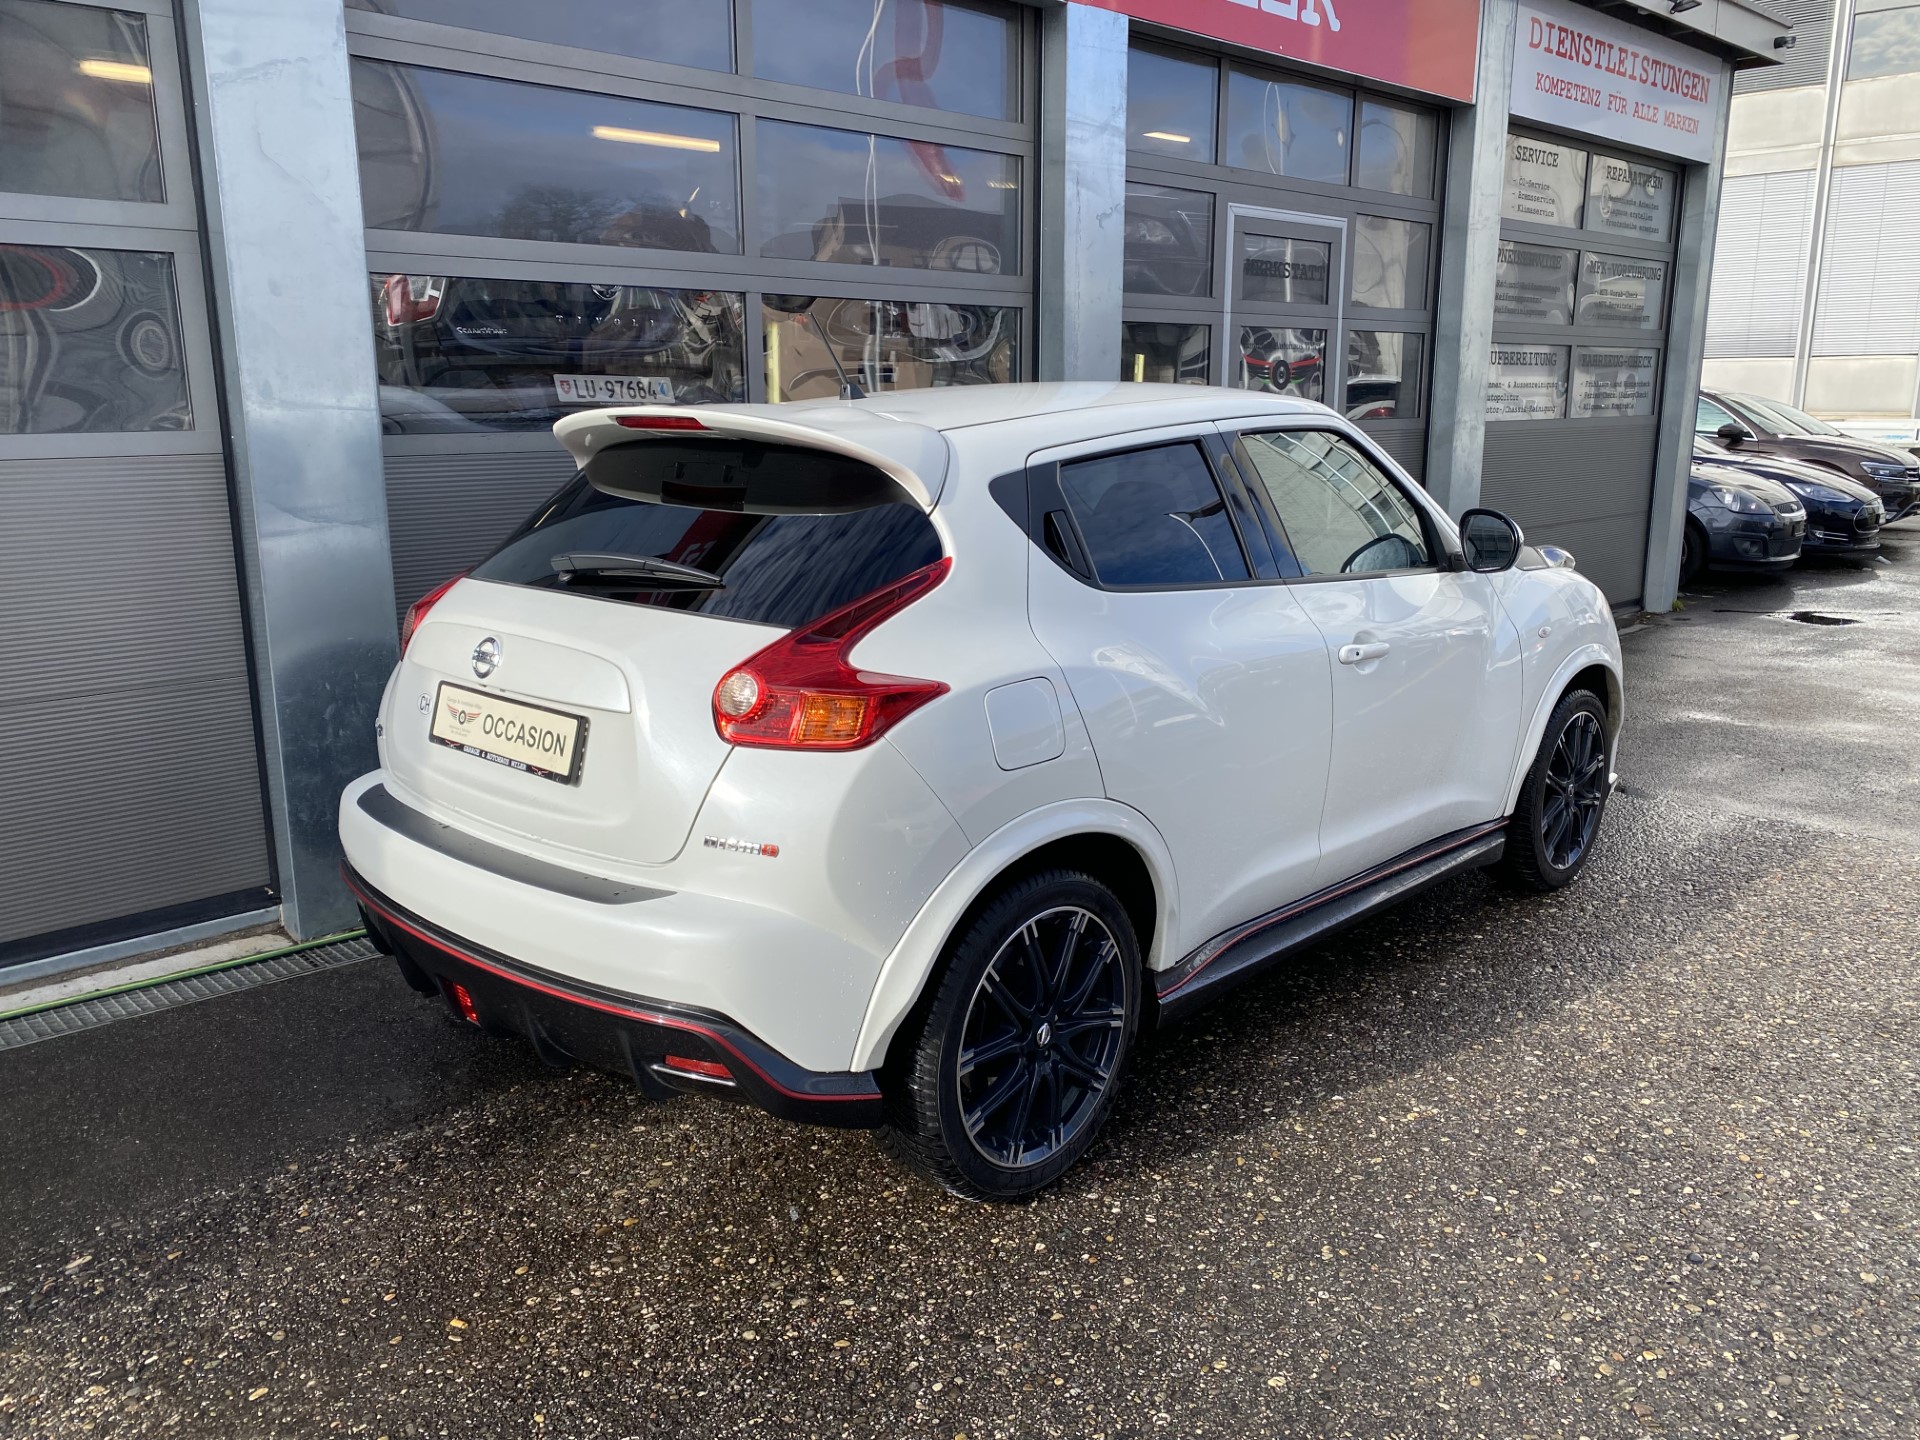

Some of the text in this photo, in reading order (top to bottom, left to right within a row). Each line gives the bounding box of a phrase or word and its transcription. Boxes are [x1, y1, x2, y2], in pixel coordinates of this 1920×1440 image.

[1529, 16, 1711, 104] DIENSTLEISTUNGEN
[1535, 72, 1700, 135] KOMPETENZ FÜR ALLE MARKEN
[1515, 145, 1559, 167] SERVICE
[1606, 165, 1664, 190] REPARATUREN
[1243, 258, 1325, 282] WERKSTATT
[1589, 260, 1662, 281] MFK-VORFÜHRUNG
[1490, 350, 1557, 367] UFBEREITUNG
[1487, 393, 1520, 404] utopolitur
[419, 695, 430, 712] CH
[482, 713, 567, 757] OCCASION
